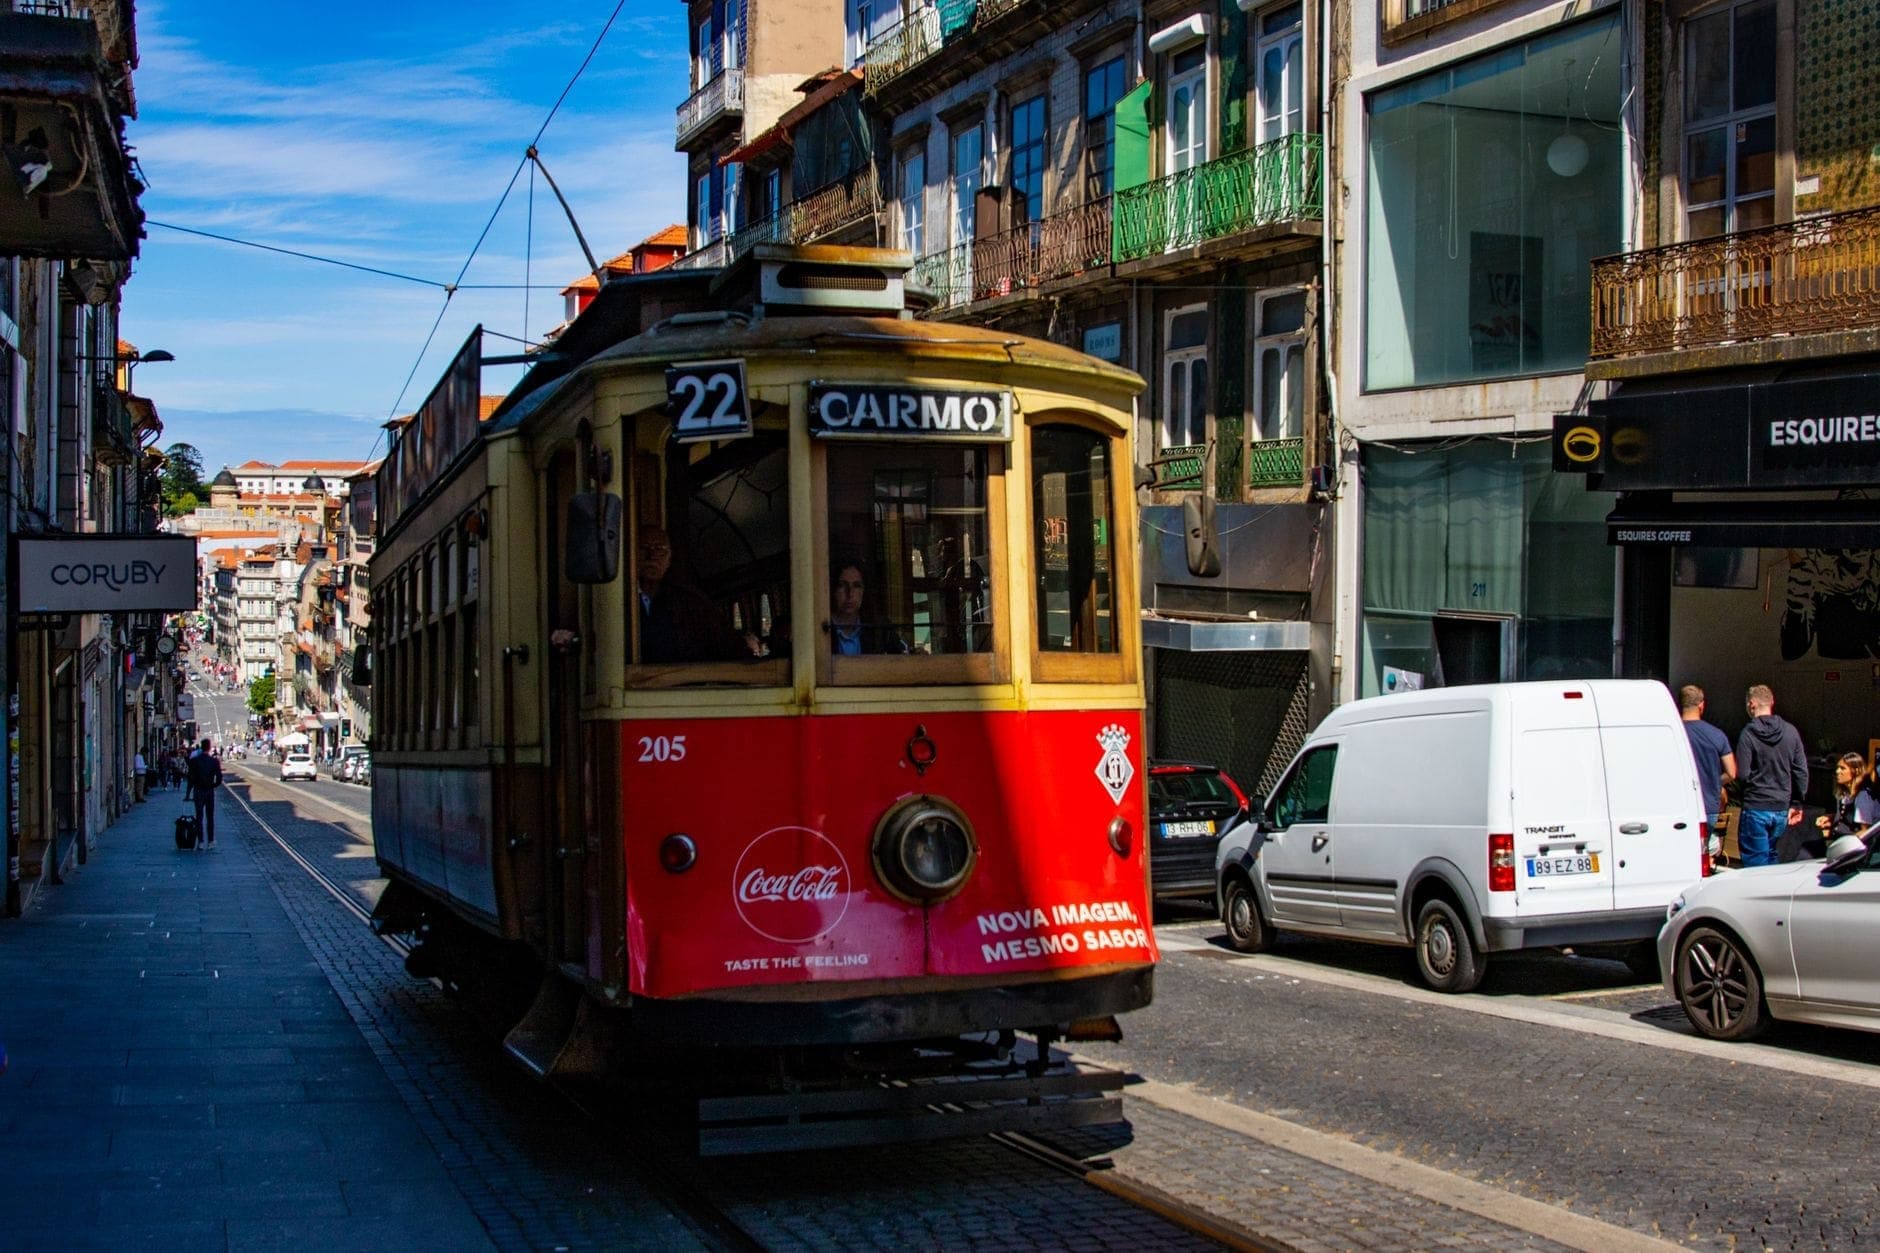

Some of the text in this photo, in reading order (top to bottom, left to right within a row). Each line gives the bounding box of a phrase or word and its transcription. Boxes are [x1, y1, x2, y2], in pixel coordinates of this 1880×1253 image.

[671, 371, 742, 431] 22
[819, 391, 997, 432] CARMO
[1617, 530, 1692, 541] ESQUIRES COFFEE
[51, 560, 167, 592] CORUBY
[1472, 582, 1487, 597] 211
[638, 735, 686, 762] 205
[1525, 825, 1565, 834] TRANSIT
[739, 865, 843, 903] Coca-Cola
[976, 901, 1138, 935] NOVA IMAGEM,
[981, 928, 1149, 963] MESMO SABOR
[724, 954, 870, 972] TASTE THE FEELING
